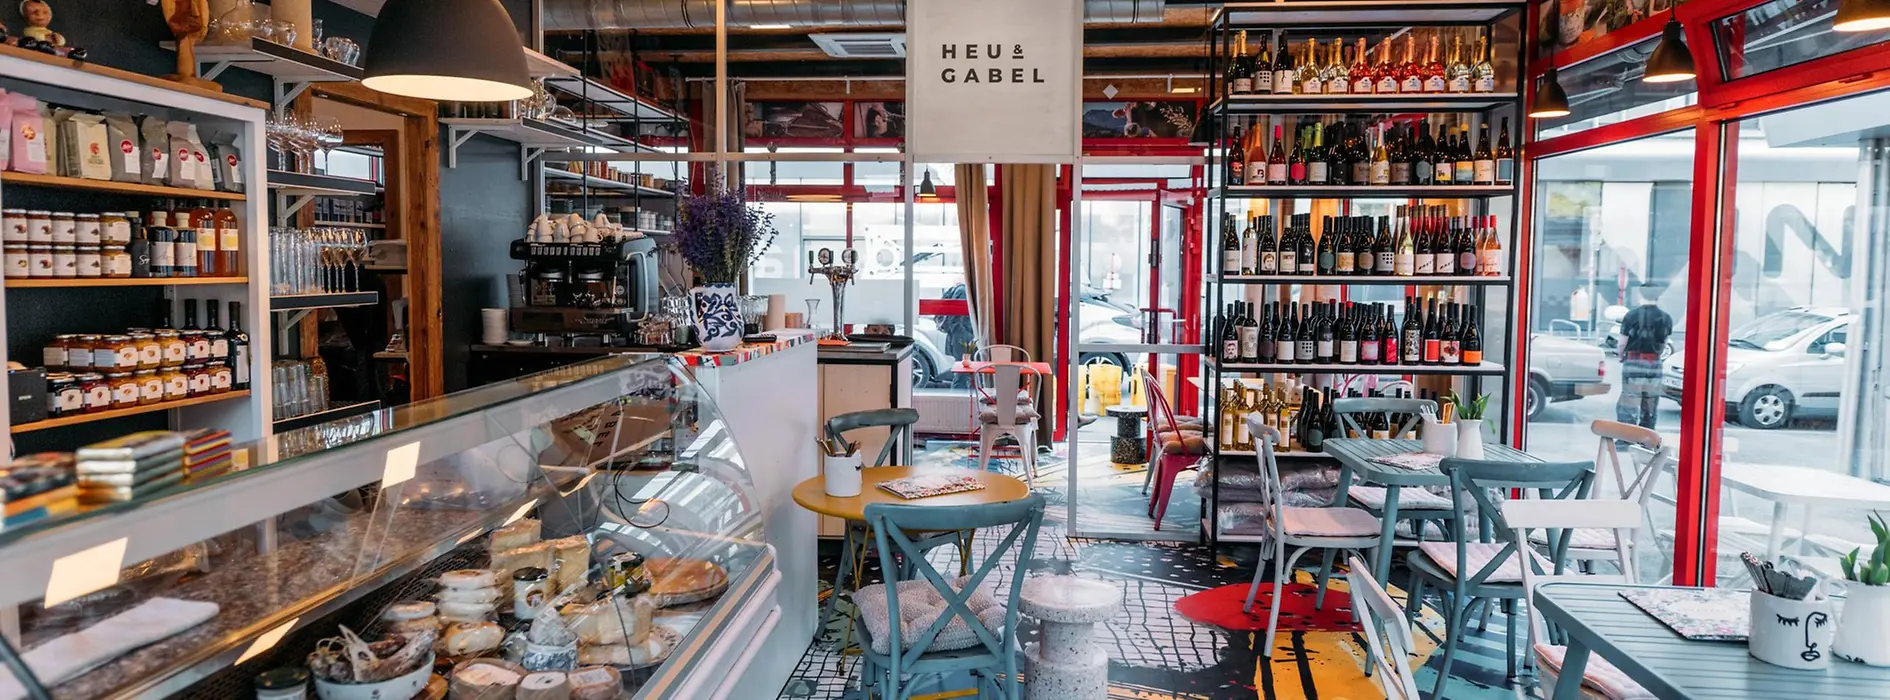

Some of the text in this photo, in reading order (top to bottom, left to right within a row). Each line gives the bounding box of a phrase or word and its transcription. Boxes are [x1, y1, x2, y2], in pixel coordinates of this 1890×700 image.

[942, 44, 1024, 59] HEU &
[942, 68, 1045, 83] GABEL
